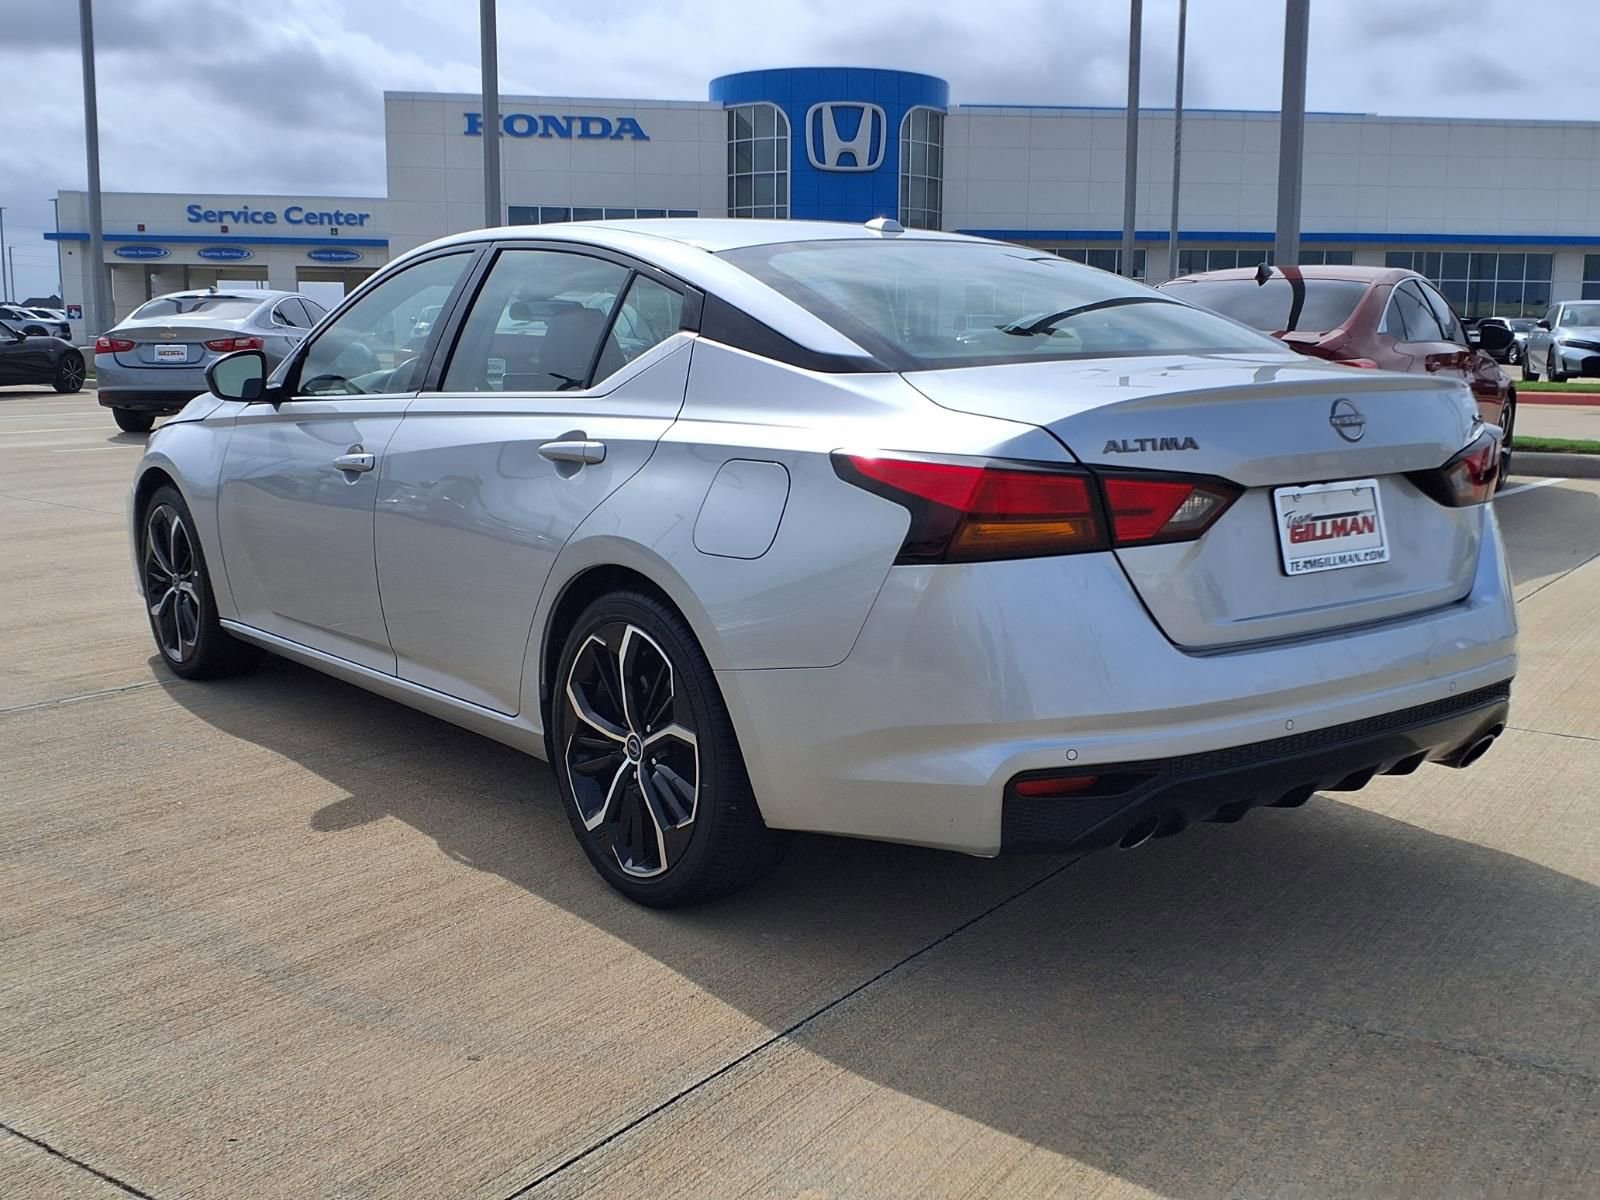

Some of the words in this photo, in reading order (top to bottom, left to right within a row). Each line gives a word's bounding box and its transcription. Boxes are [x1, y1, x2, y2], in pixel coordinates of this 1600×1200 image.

[463, 112, 650, 141] HONDA
[186, 204, 277, 224] Service
[284, 206, 370, 226] Center
[1102, 436, 1200, 454] ALTIMA
[1284, 509, 1312, 529] Team
[1290, 514, 1376, 545] GILLMAN
[1290, 549, 1385, 572] TEAMGILLMAN.COM
